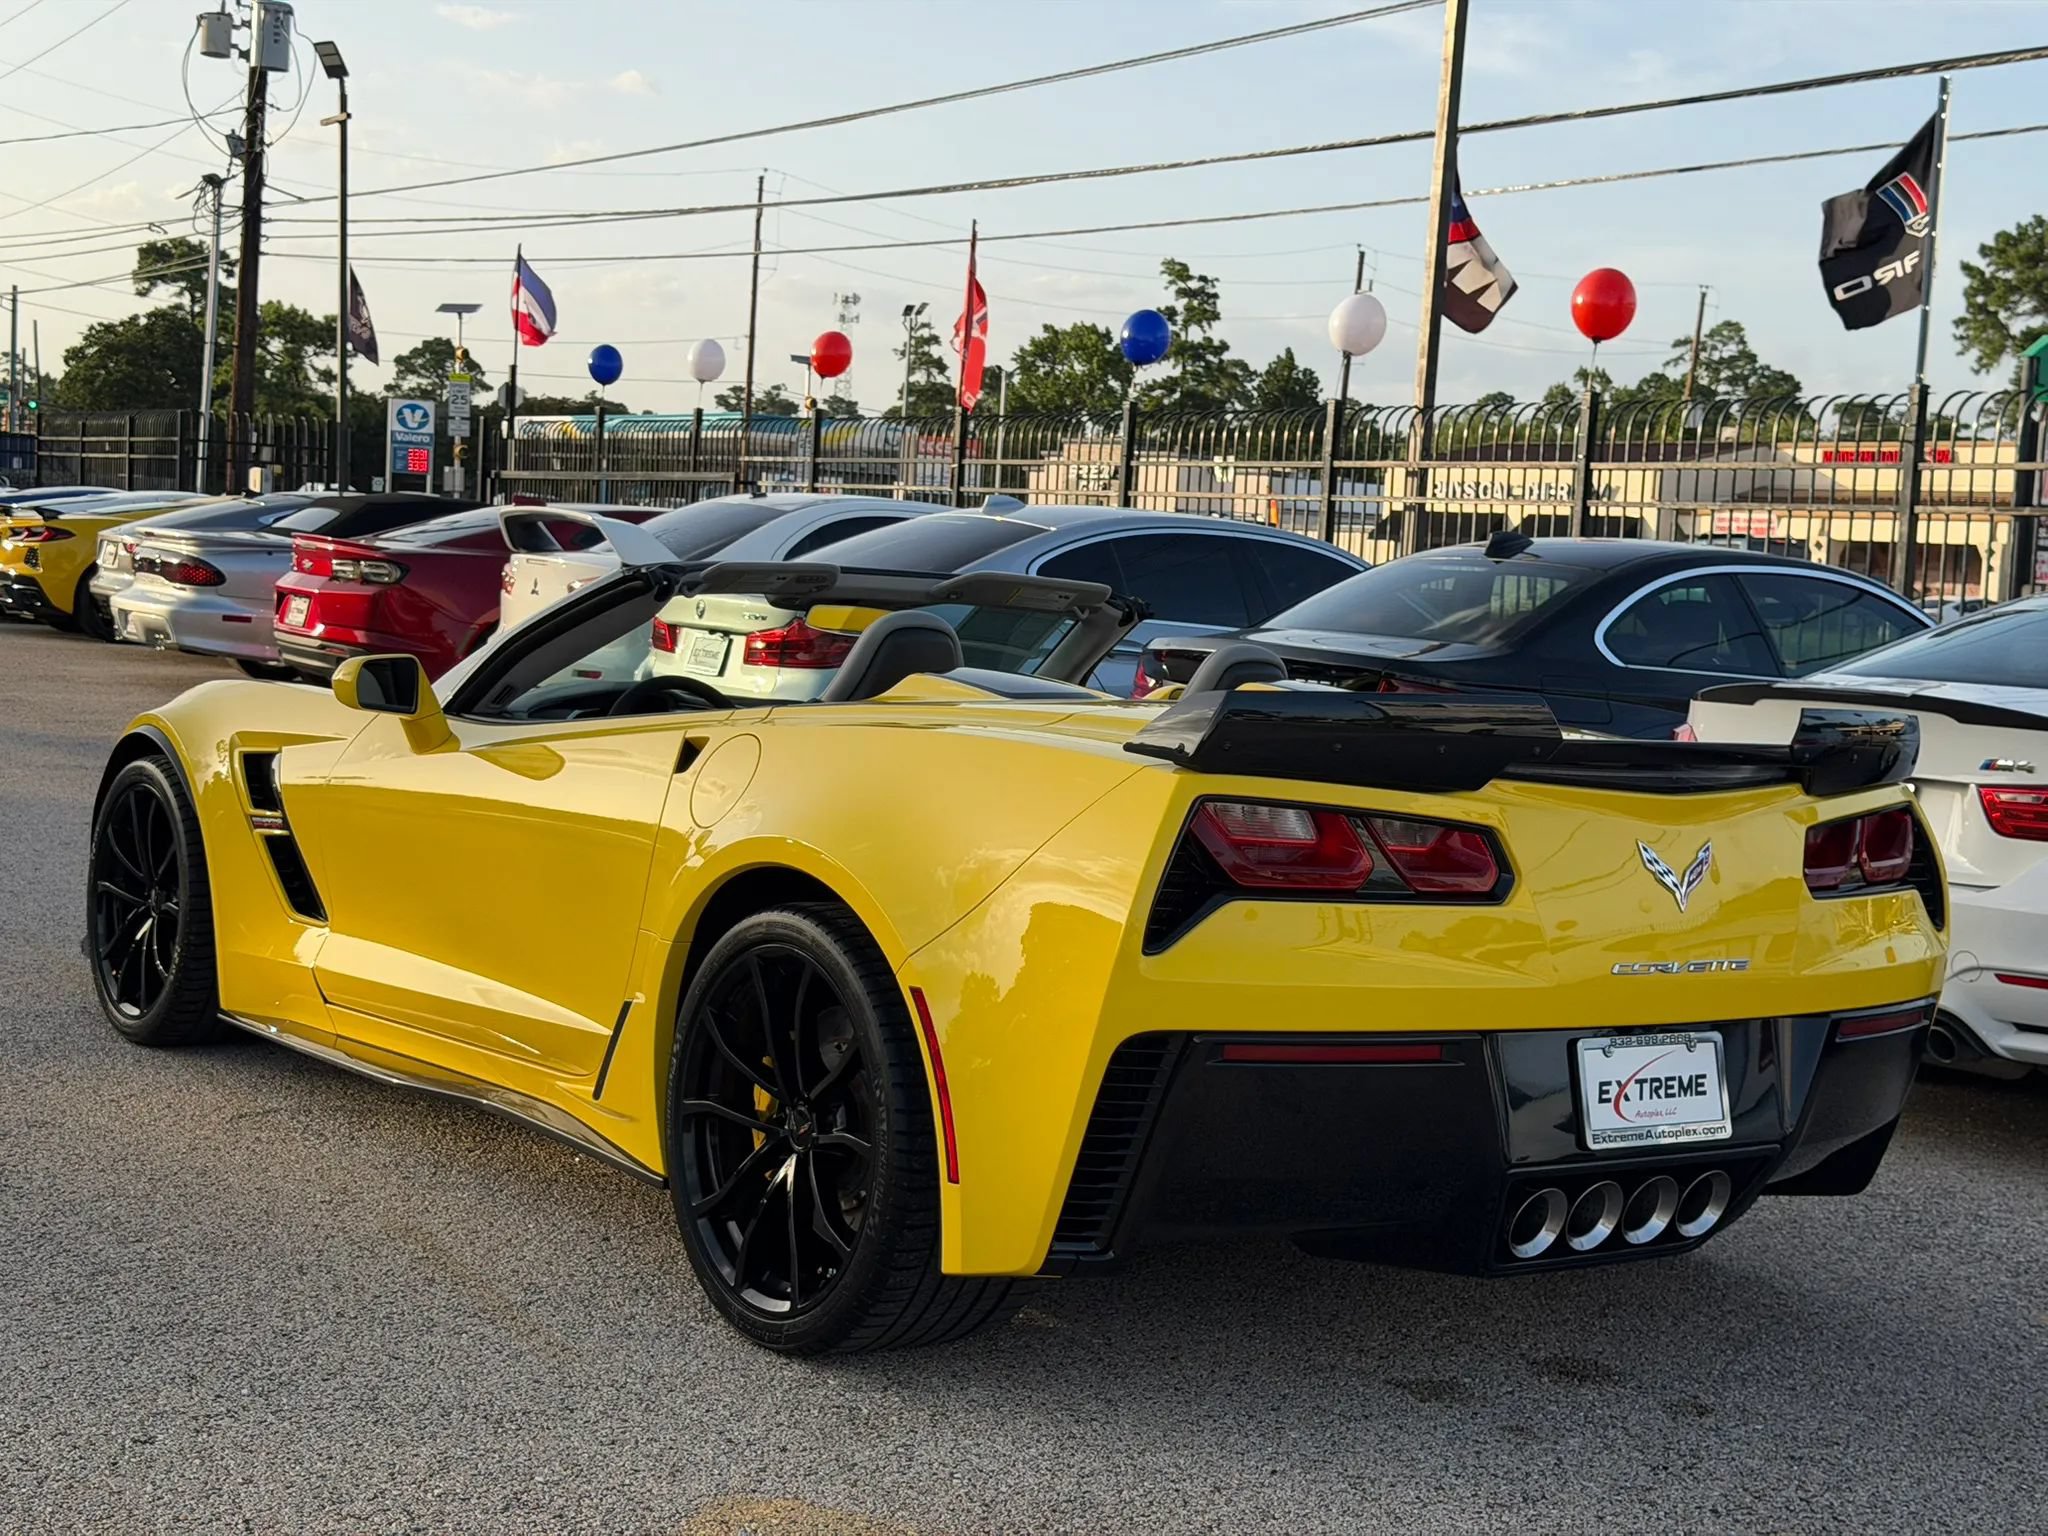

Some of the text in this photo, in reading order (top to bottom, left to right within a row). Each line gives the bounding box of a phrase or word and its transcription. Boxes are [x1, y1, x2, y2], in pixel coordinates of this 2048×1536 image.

[451, 394, 468, 405] 25
[395, 432, 430, 443] Valero
[1611, 959, 1750, 976] CORVETTE
[1597, 1073, 1708, 1105] EXTREME
[1591, 1124, 1728, 1145] ExtremeAutoplex.com
